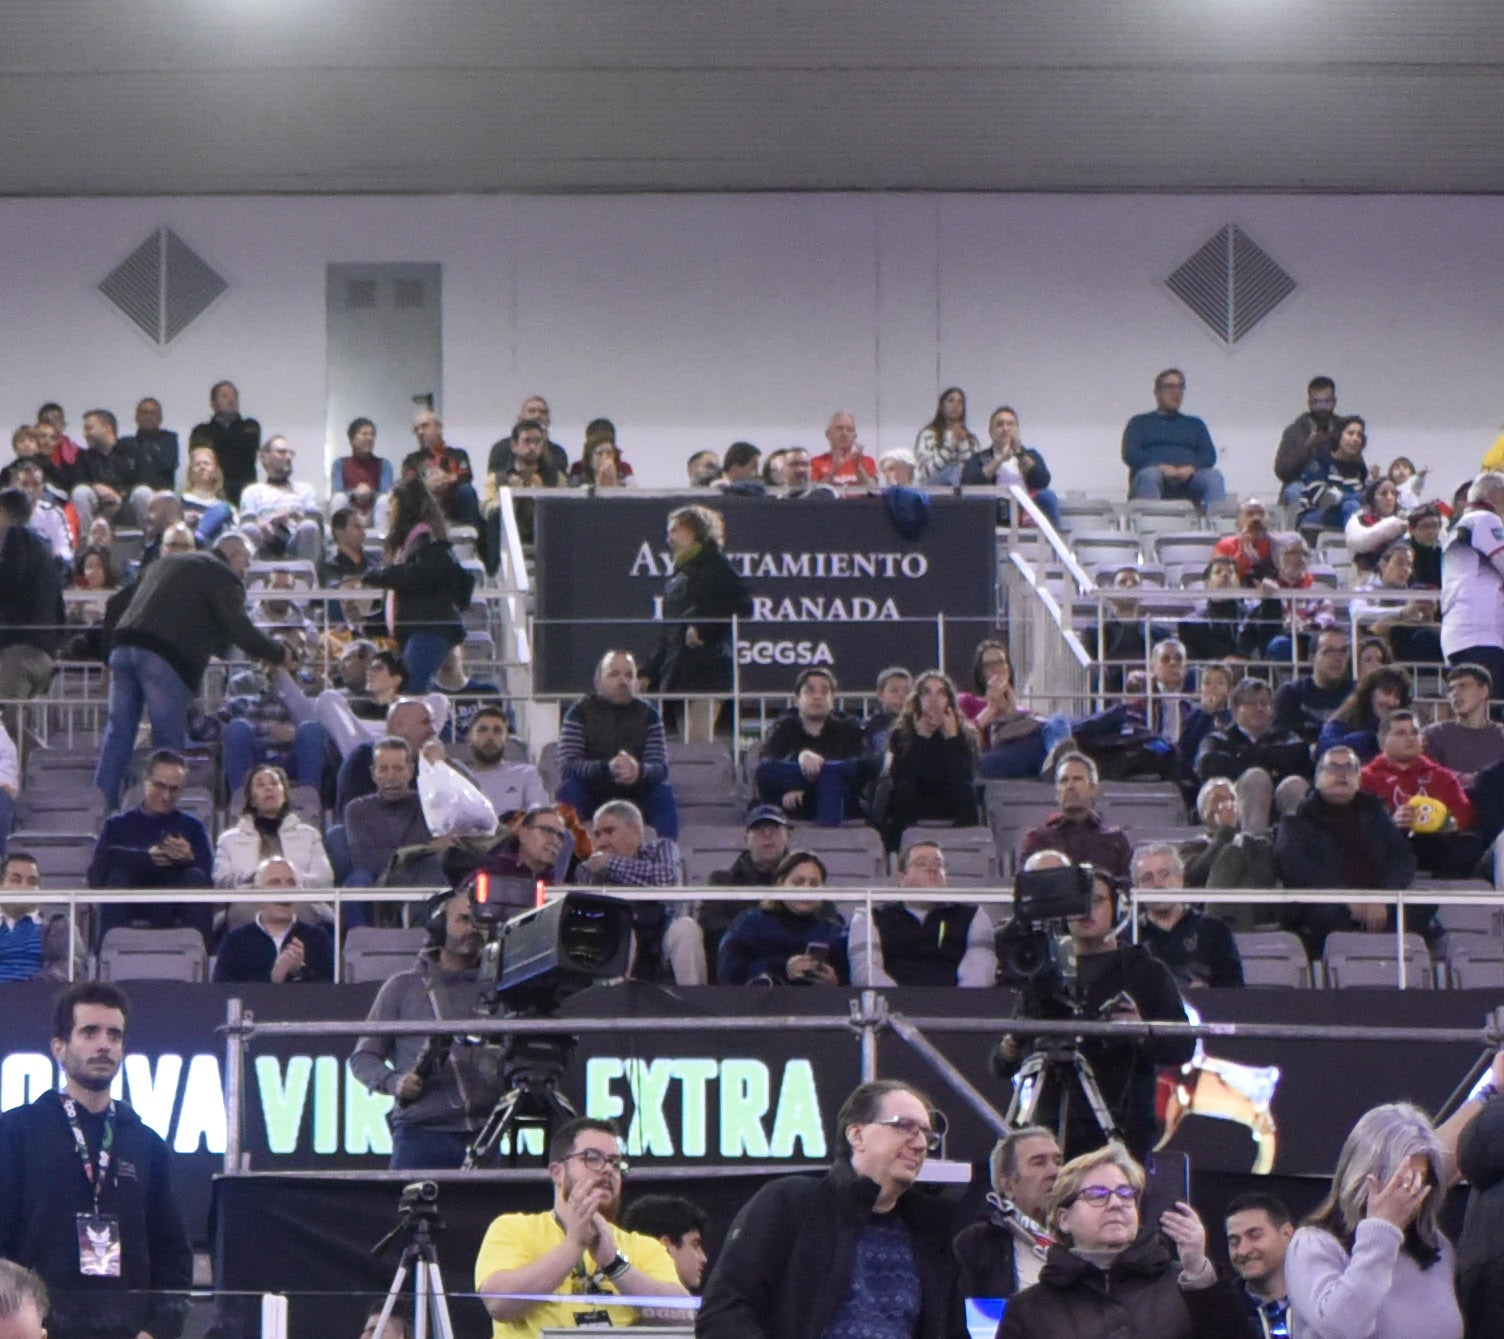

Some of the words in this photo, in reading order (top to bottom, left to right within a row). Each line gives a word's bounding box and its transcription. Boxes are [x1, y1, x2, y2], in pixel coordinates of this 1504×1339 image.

[629, 541, 928, 579] AYTAMIENTO
[751, 596, 901, 622] RANADA
[0, 1053, 227, 1154] OVA
[586, 1057, 827, 1158] EXTRA
